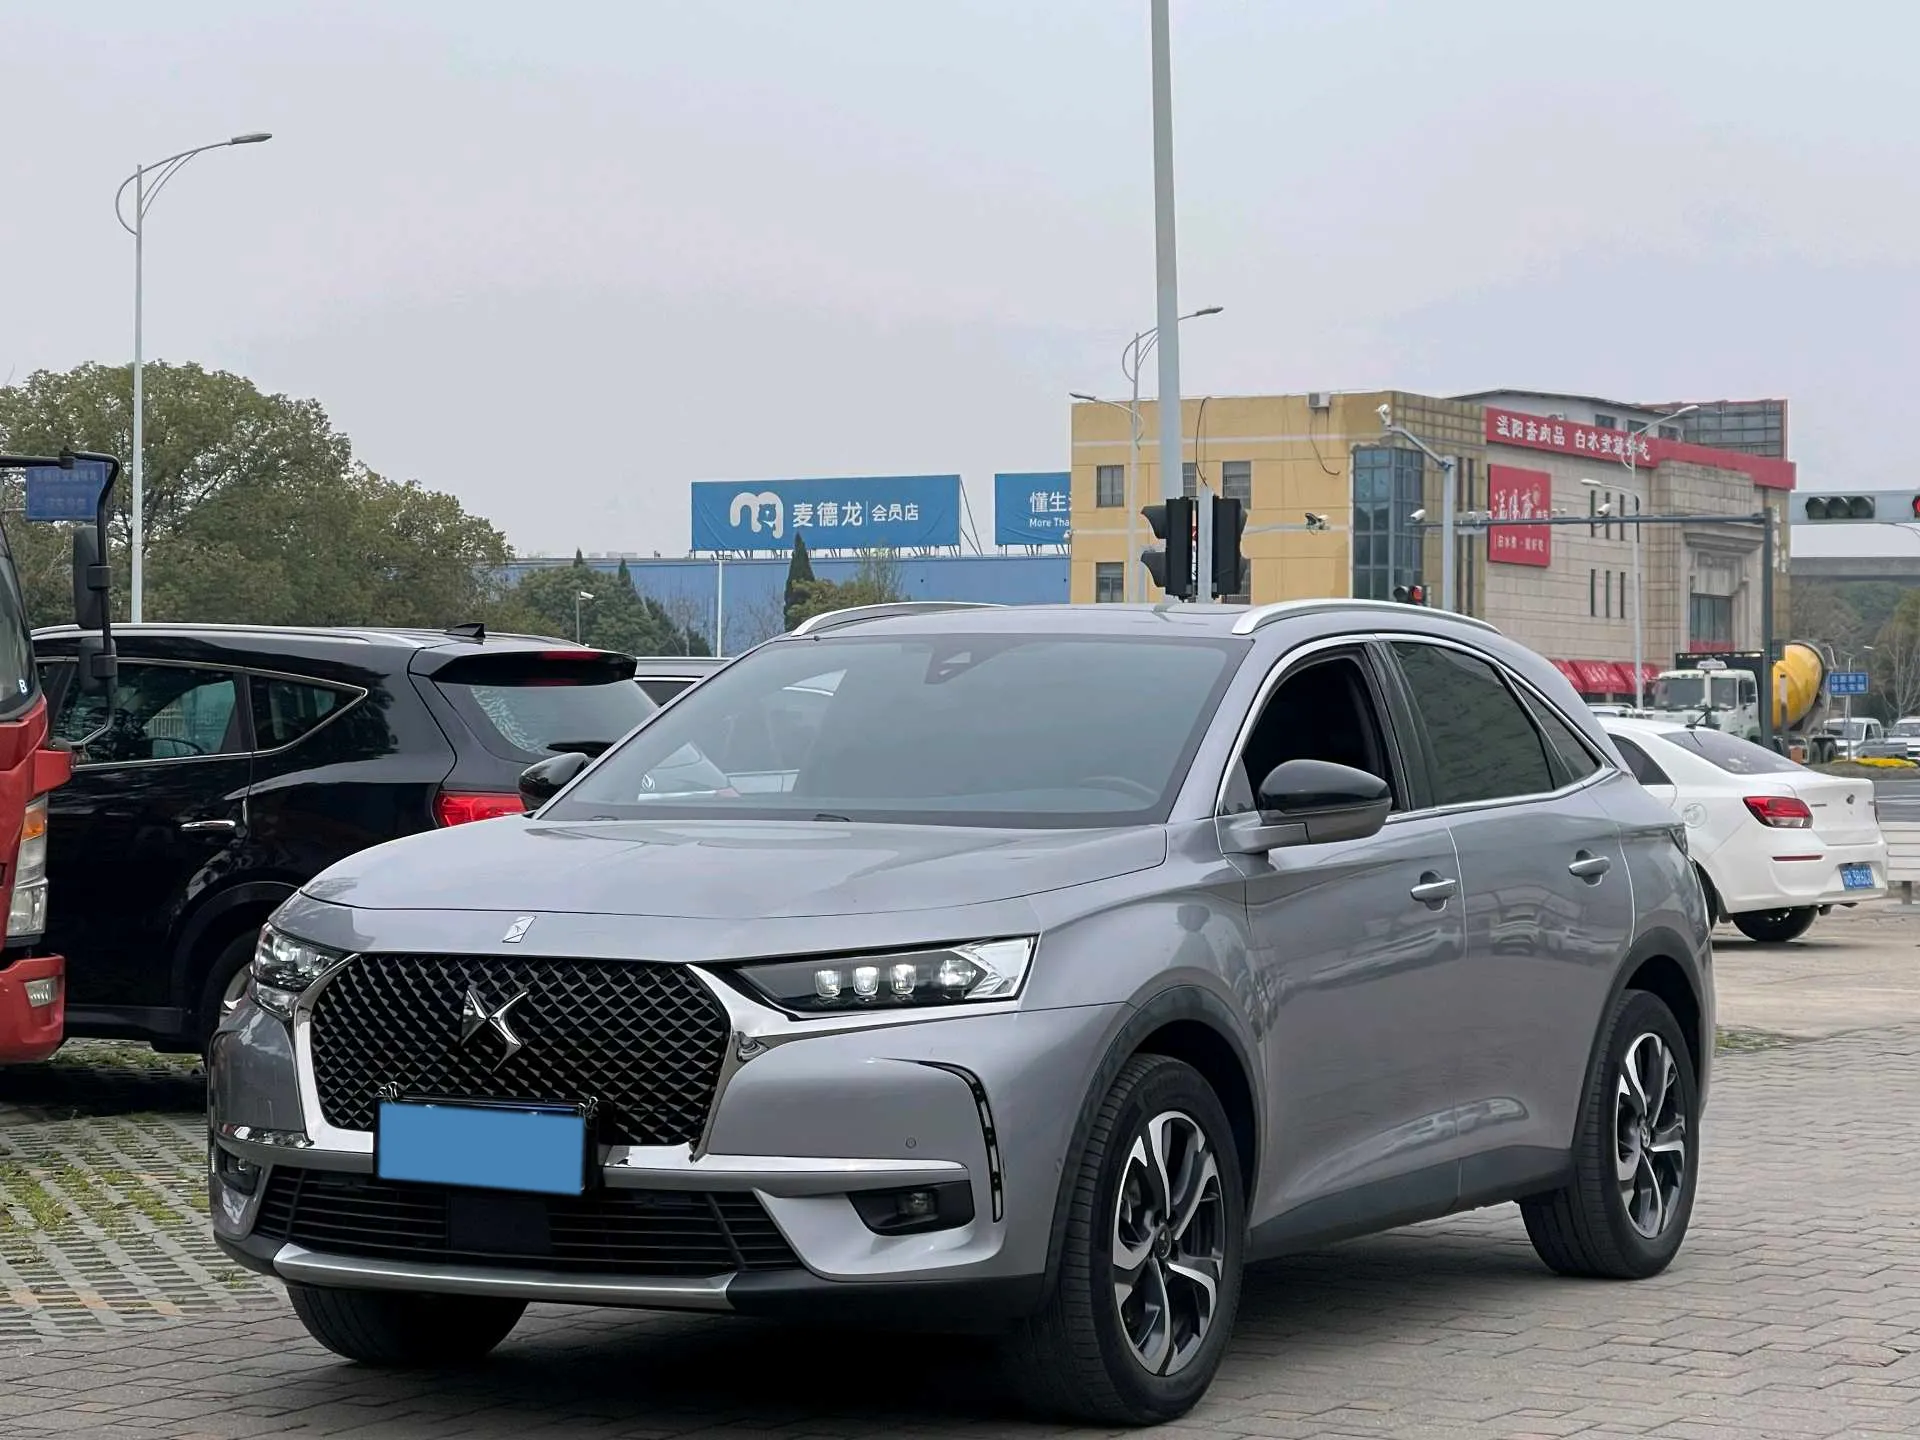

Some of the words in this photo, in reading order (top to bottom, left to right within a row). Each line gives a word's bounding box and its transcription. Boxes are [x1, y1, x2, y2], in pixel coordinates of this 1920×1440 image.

[1030, 491, 1071, 512] 懂生
[792, 501, 863, 528] 麦德龙
[871, 502, 919, 522] 会员店
[1030, 518, 1051, 527] More
[1053, 517, 1070, 527] Tha
